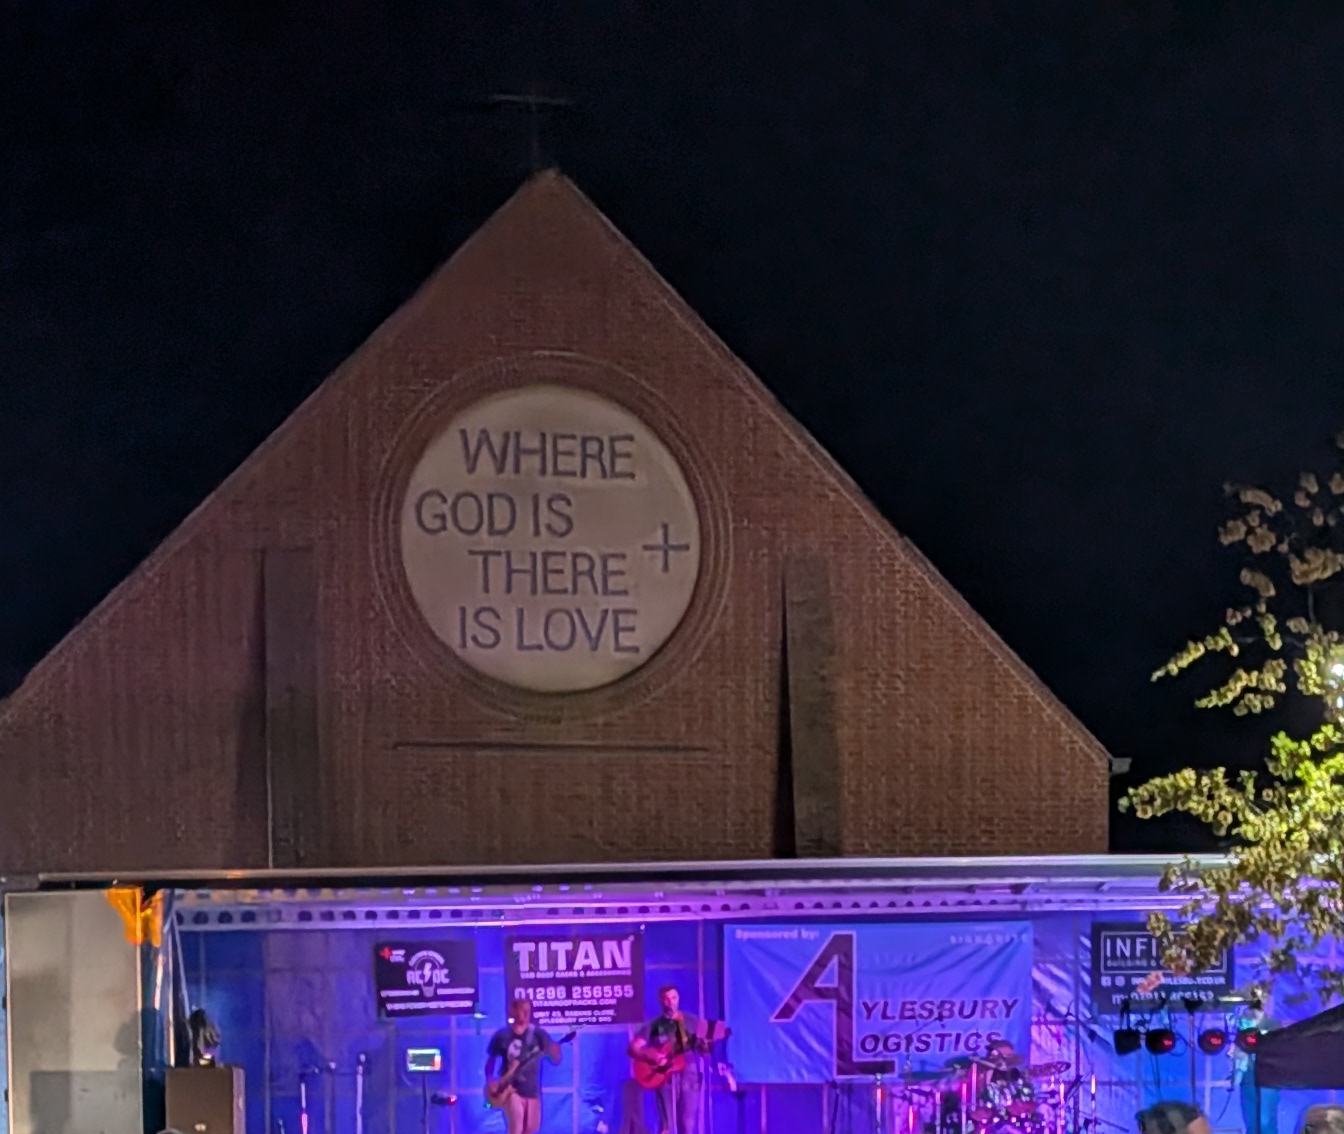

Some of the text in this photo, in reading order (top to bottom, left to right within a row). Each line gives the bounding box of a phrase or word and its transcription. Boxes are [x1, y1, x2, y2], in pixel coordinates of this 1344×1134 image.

[459, 428, 636, 480] WHERE
[414, 490, 574, 538] GOD IS
[467, 548, 630, 597] THERE
[459, 606, 641, 654] IS LOVE
[513, 940, 632, 971] TITAN
